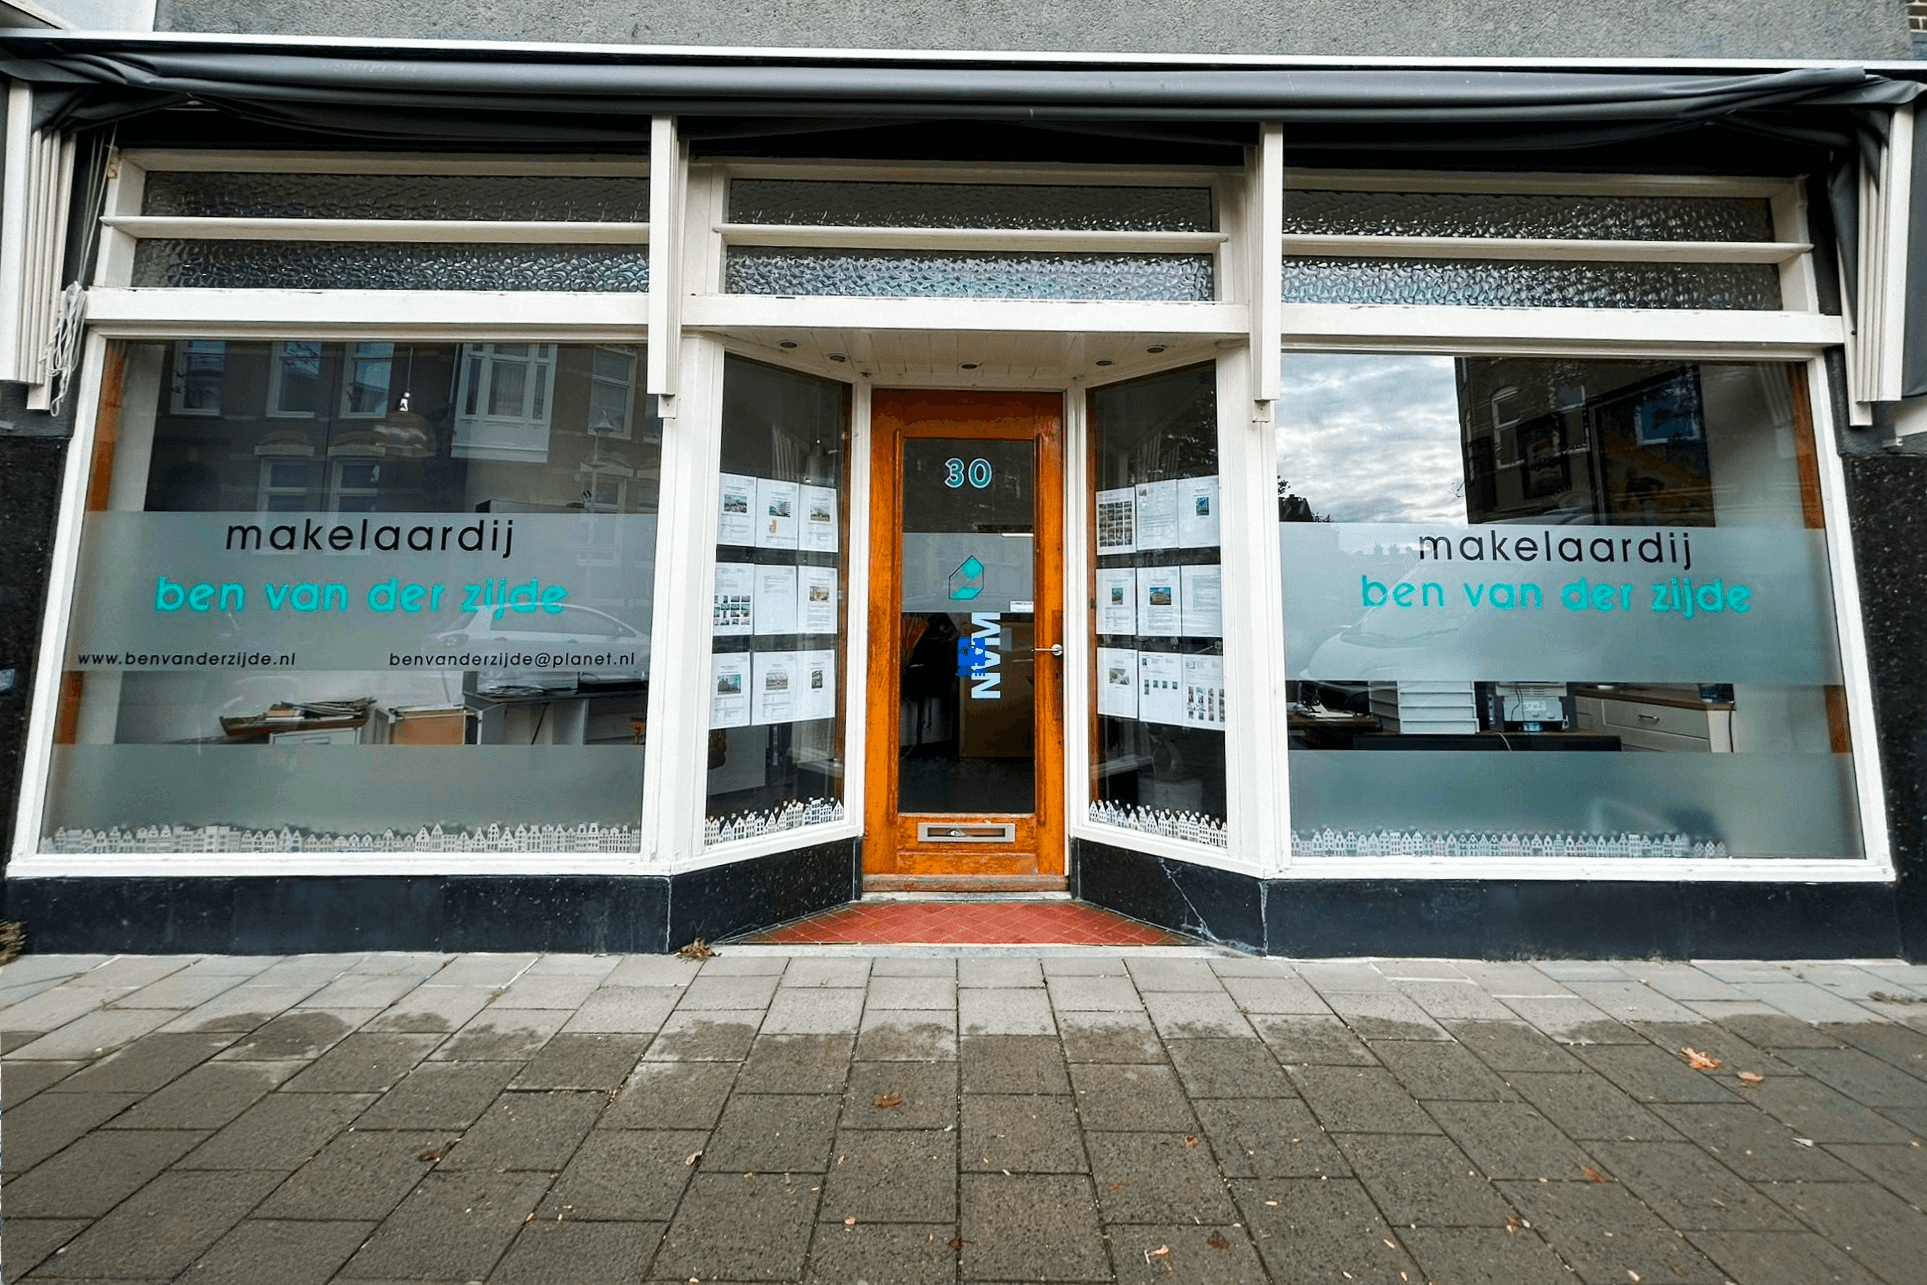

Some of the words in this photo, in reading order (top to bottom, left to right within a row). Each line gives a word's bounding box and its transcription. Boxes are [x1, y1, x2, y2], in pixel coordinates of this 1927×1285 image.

[944, 458, 993, 489] 30
[226, 518, 514, 559] makelaardij
[1419, 530, 1692, 571] makelaardij
[154, 576, 246, 613] ben
[265, 583, 348, 612] van
[368, 577, 444, 613] der
[461, 578, 568, 620] zijde
[1362, 576, 1444, 607] ben
[1464, 582, 1542, 612] van
[1561, 577, 1633, 612] der
[1651, 576, 1752, 621] zijde
[77, 652, 296, 668] www.benvanderzijde.nl
[389, 652, 635, 668] benvanderzijde@planet.nl
[970, 612, 1002, 699] NVM
